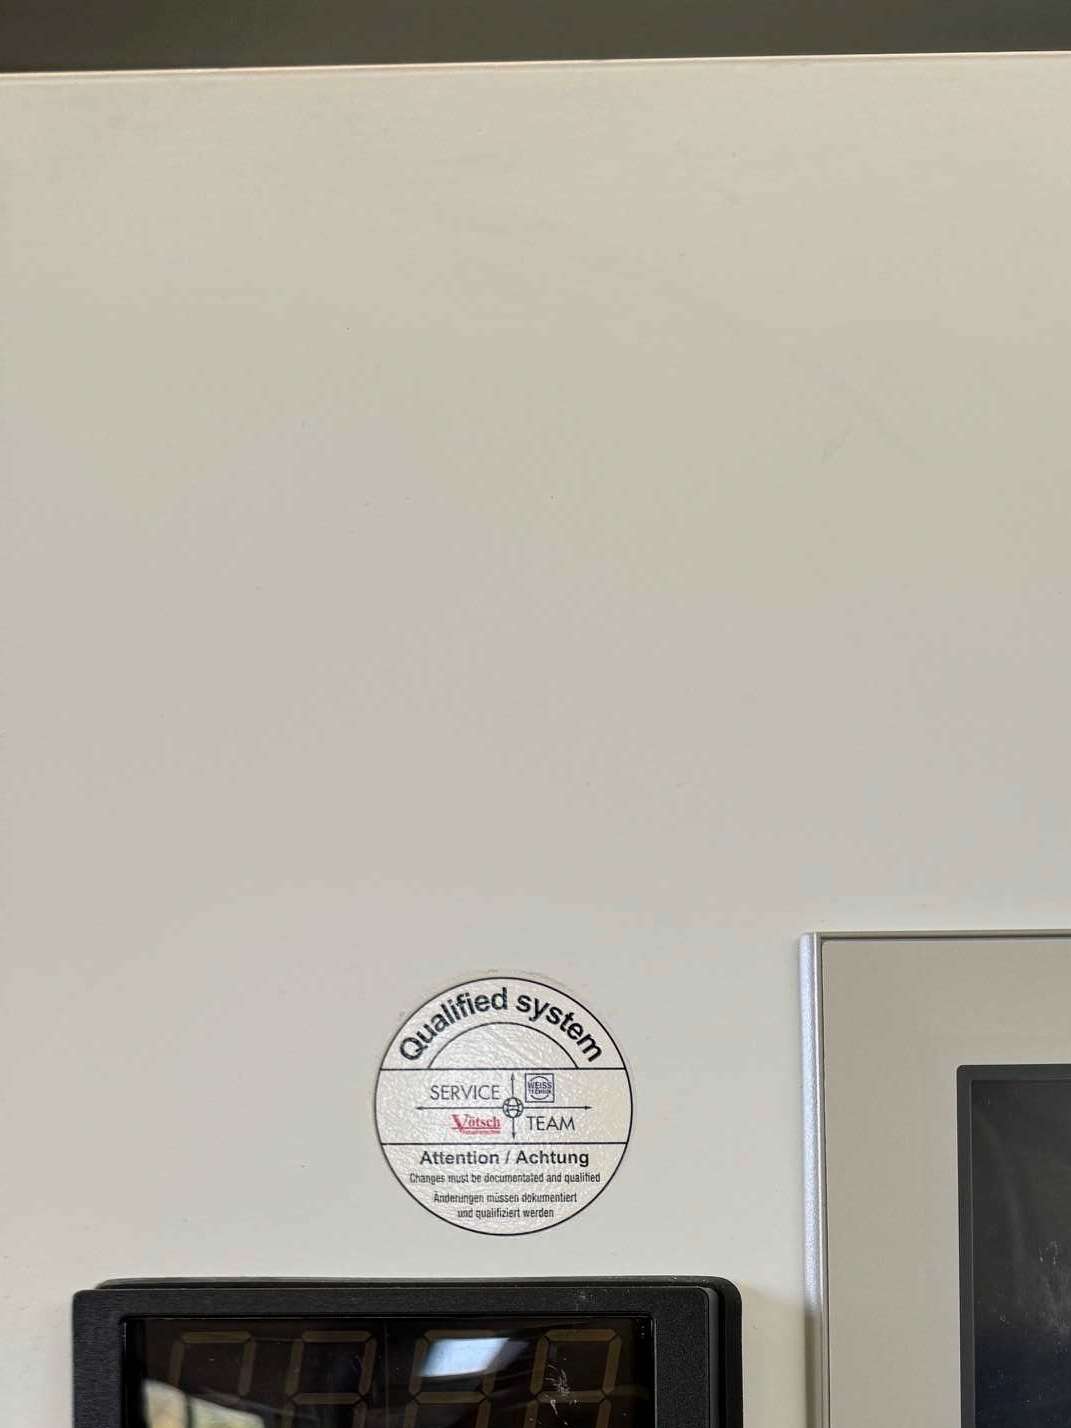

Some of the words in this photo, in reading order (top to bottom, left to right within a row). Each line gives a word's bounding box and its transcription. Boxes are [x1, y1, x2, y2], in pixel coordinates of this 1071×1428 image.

[400, 987, 508, 1061] Qualified
[516, 994, 603, 1063] system
[430, 1085, 500, 1100] SERVICE
[526, 1116, 575, 1130] TEAM
[420, 1151, 499, 1165] Attention
[505, 1151, 510, 1165] /
[516, 1151, 589, 1167] Achtung
[410, 1173, 445, 1185] Changes
[448, 1174, 469, 1183] must
[471, 1173, 482, 1183] be
[546, 1173, 562, 1183] and
[565, 1172, 600, 1184] qualified
[487, 1192, 519, 1202] müssen
[522, 1192, 577, 1202] dokumentiert
[458, 1208, 473, 1218] und
[476, 1208, 520, 1218] qualifiziert
[523, 1208, 554, 1218] werden
